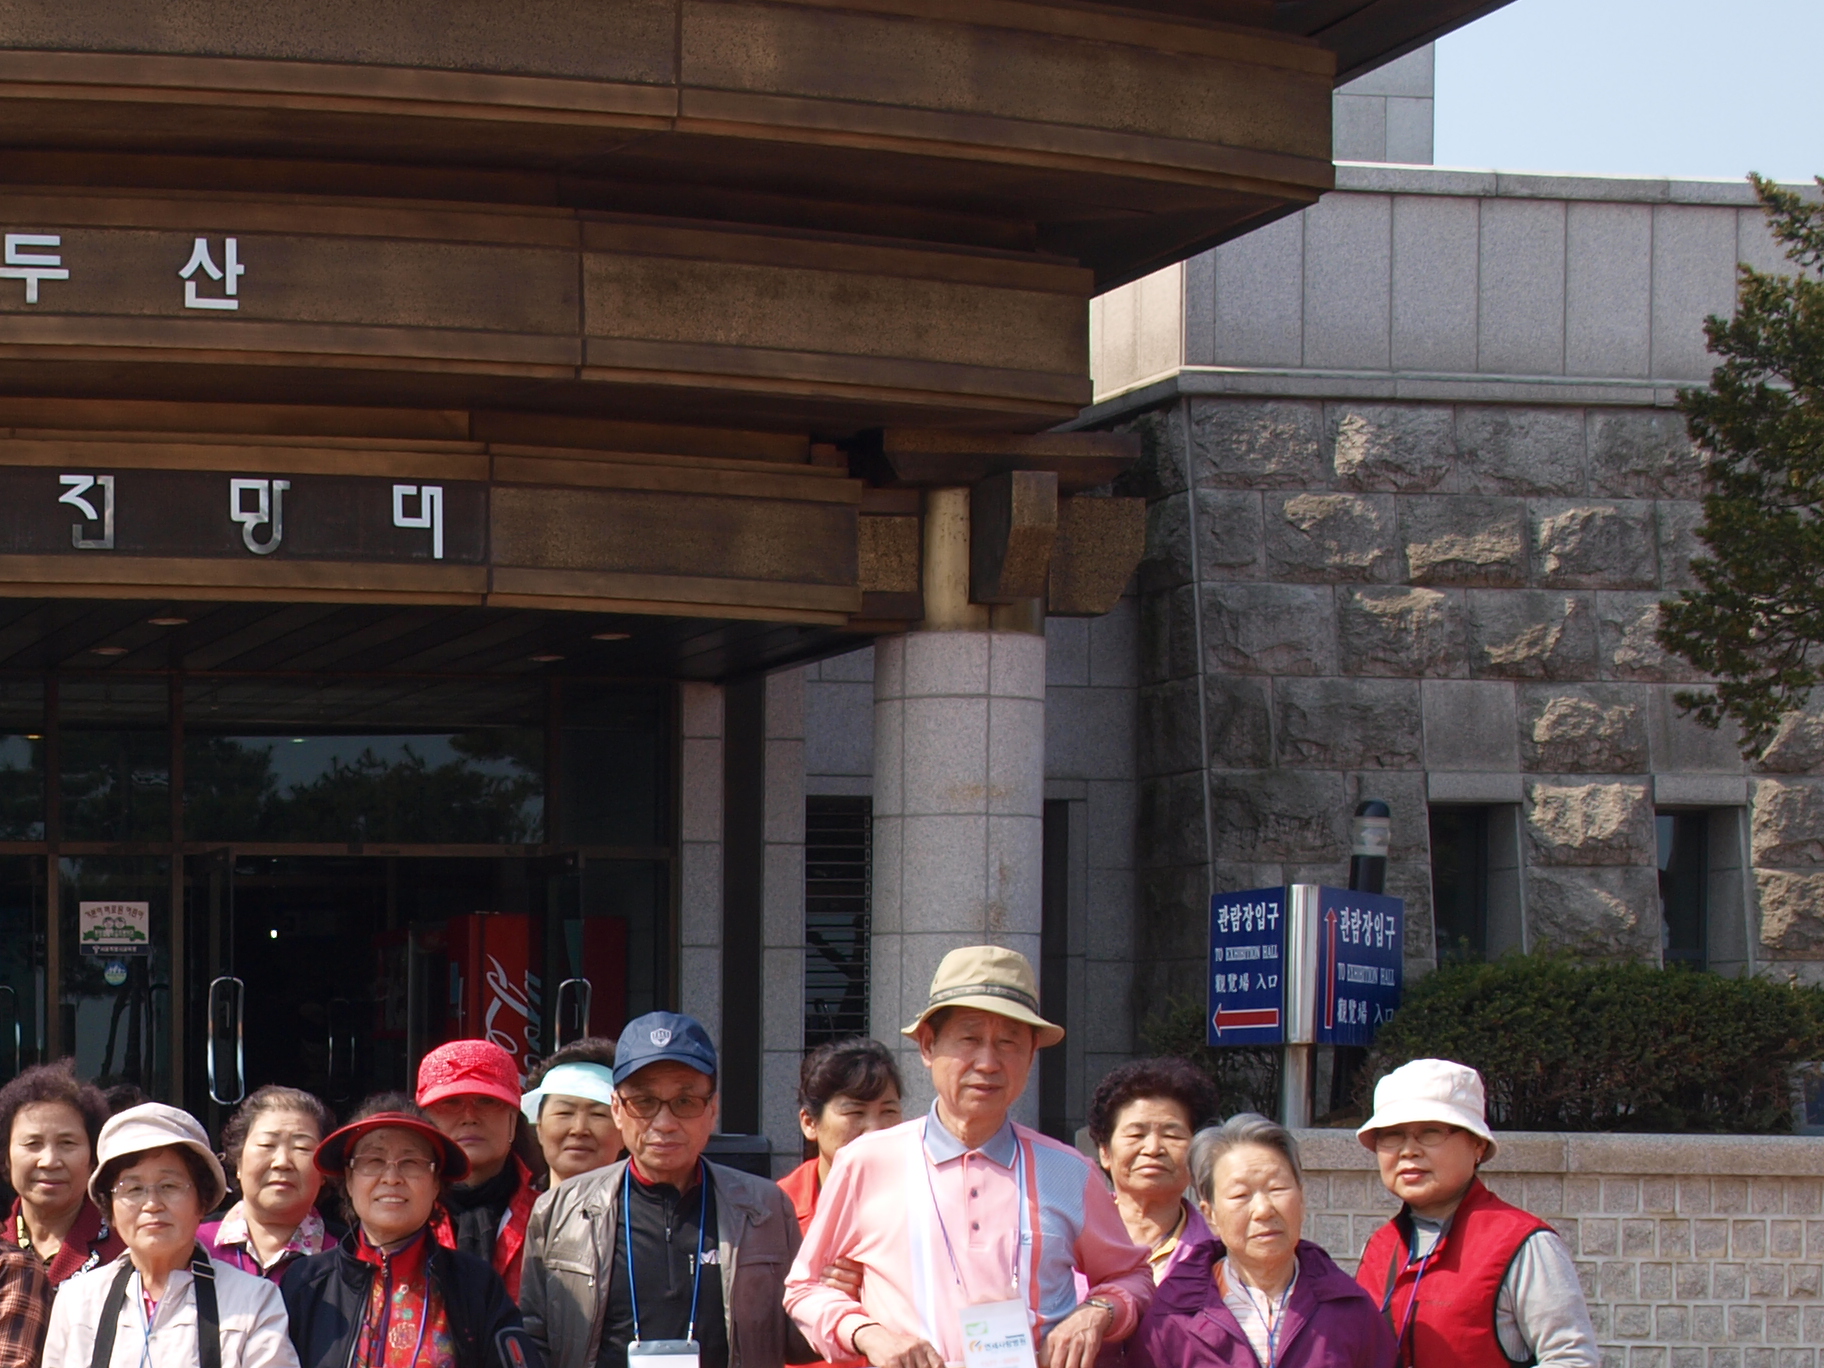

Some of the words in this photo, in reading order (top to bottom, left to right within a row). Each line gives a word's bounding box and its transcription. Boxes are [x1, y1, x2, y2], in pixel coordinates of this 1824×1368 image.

[1217, 902, 1280, 934] 관람장입구
[1339, 906, 1396, 951] 관람장입구
[1215, 947, 1223, 962] TO
[1225, 945, 1261, 962] EXHIBITION
[1262, 944, 1278, 960] HALL
[1256, 973, 1278, 991] 入口
[1337, 962, 1345, 983] TO
[1347, 963, 1378, 986] EXHIBITION
[1380, 967, 1395, 987] HALL
